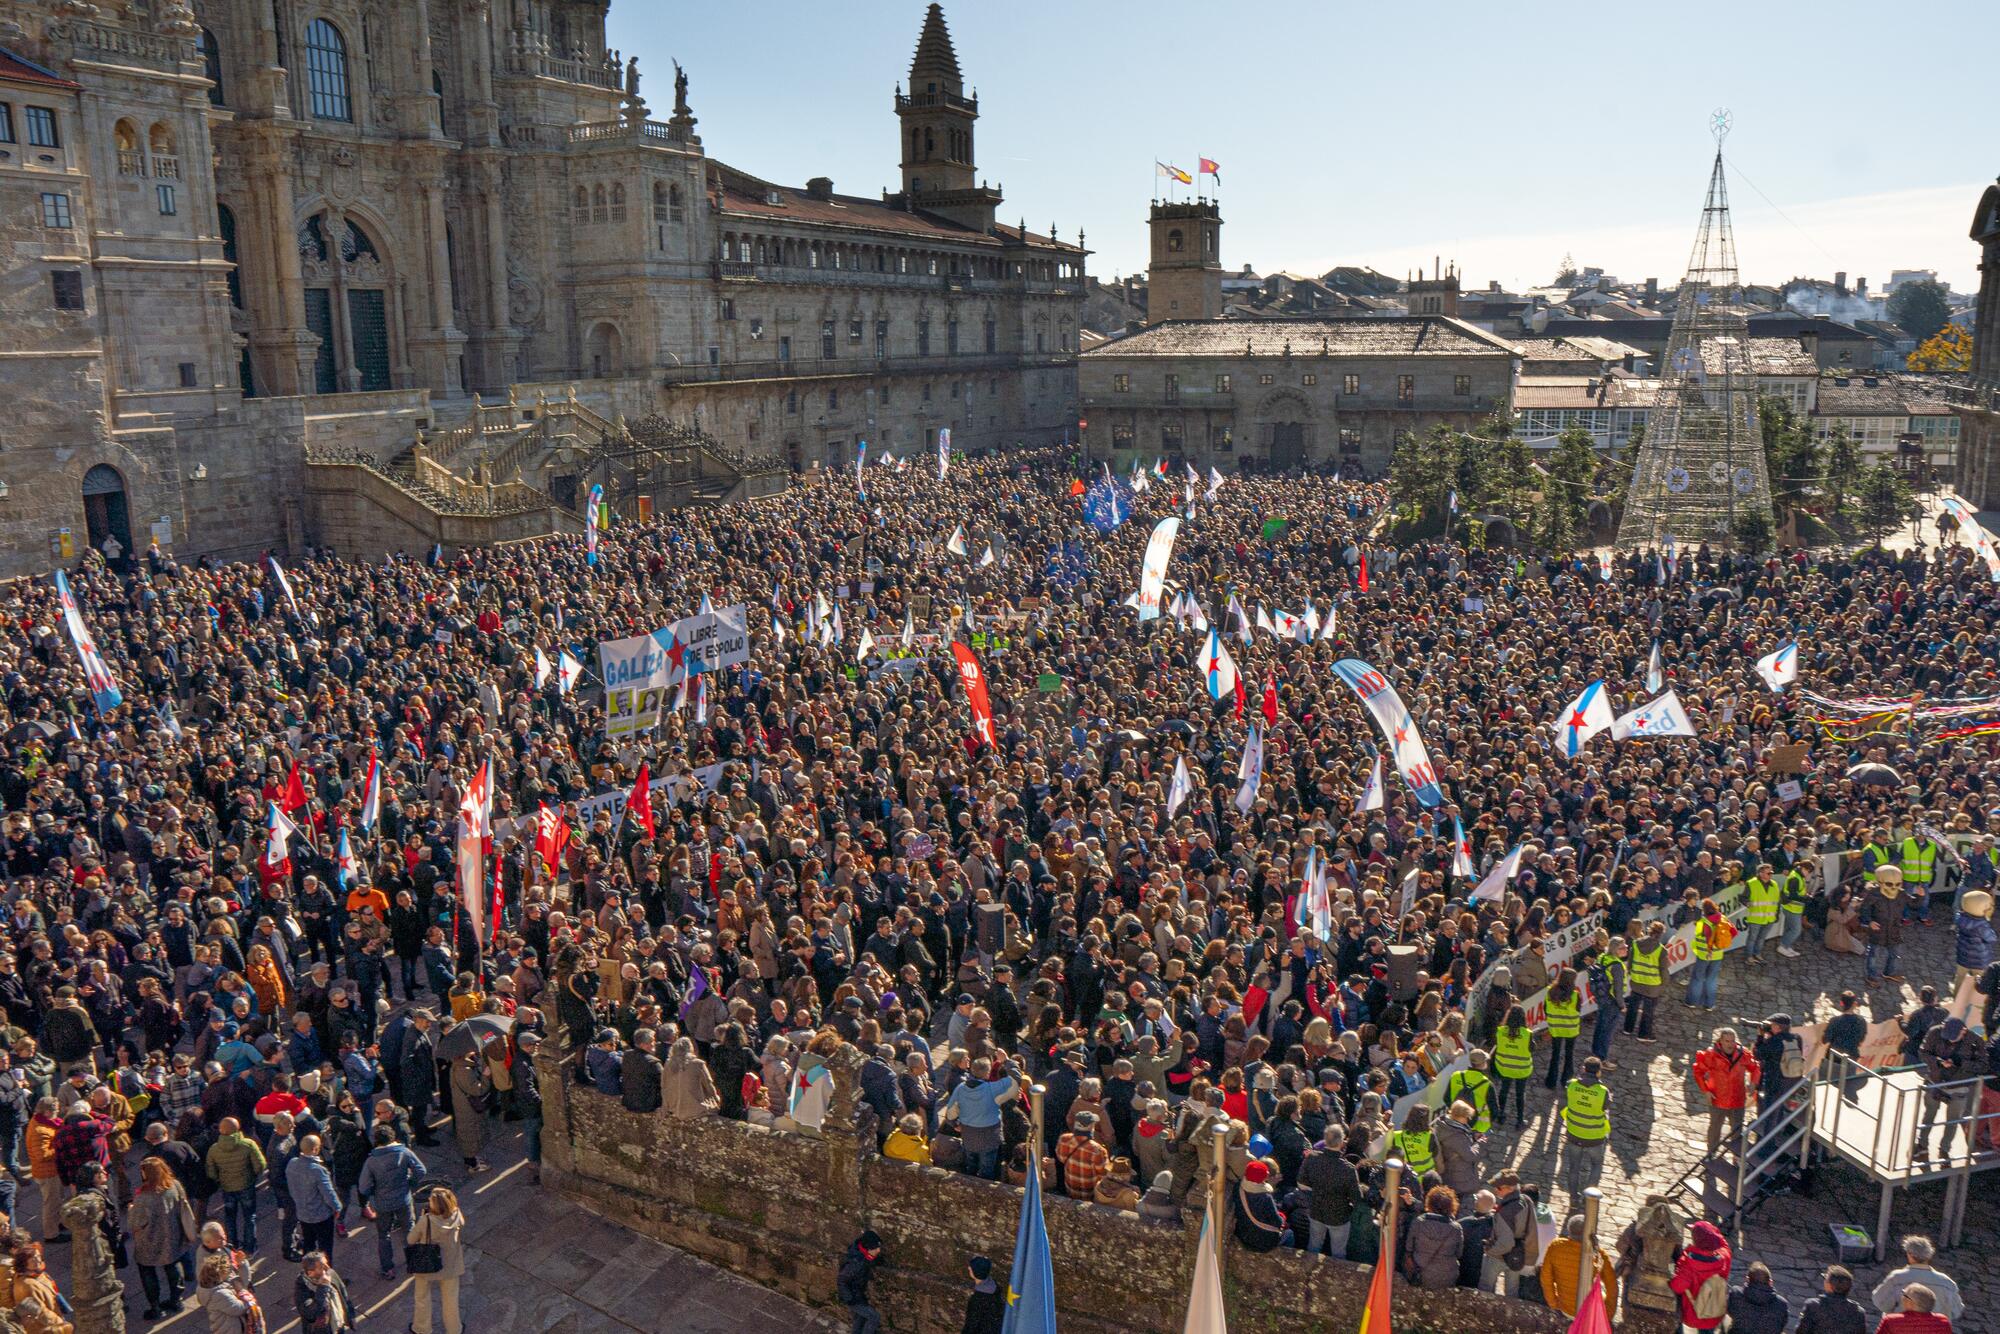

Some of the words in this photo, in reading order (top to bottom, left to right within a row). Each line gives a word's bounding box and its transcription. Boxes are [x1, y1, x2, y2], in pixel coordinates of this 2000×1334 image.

[689, 624, 718, 645] LIBRE
[690, 648, 702, 664] DE
[706, 636, 744, 659] ESPOLIO
[606, 650, 663, 686] GALIZA
[1570, 914, 1601, 943] SEXO
